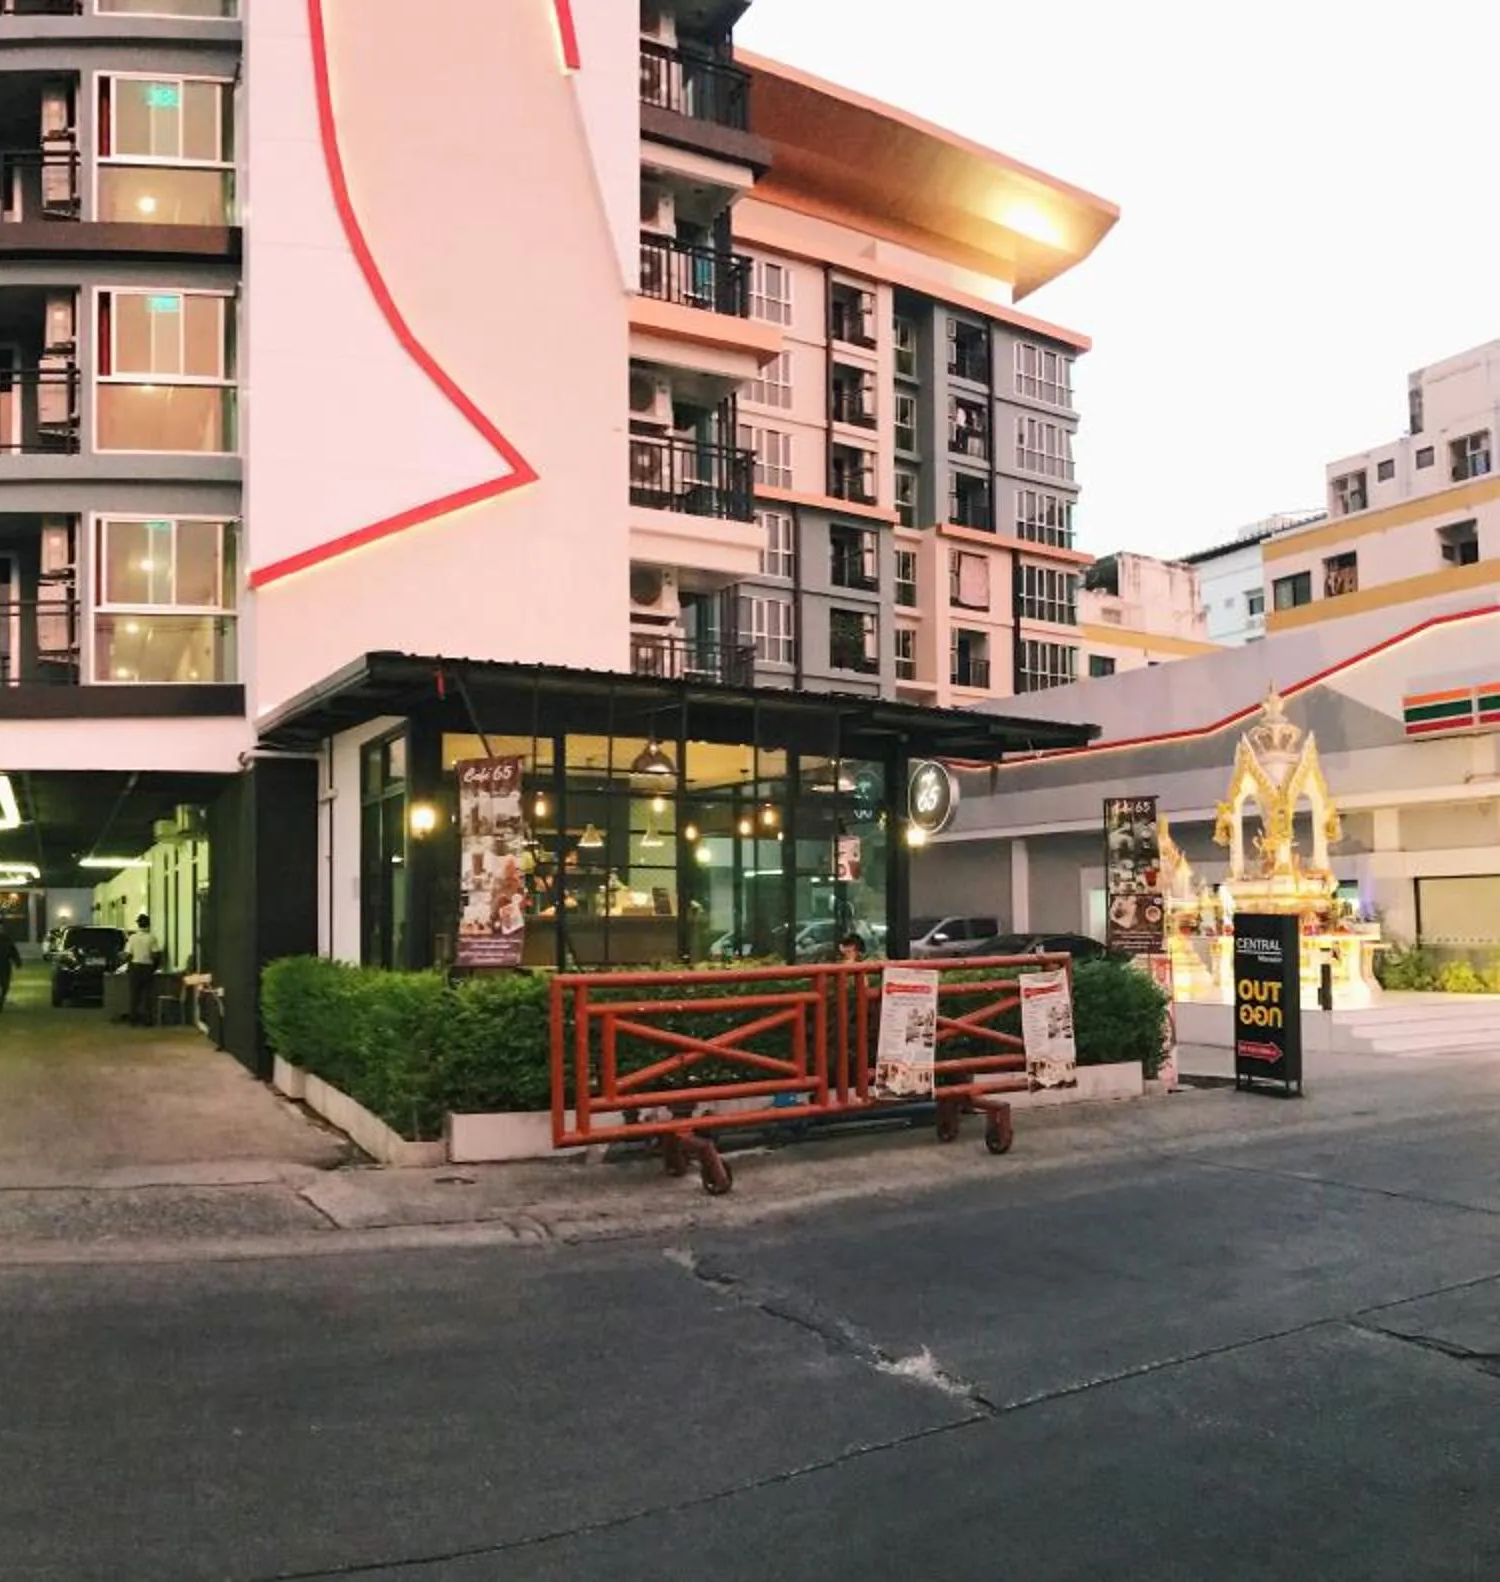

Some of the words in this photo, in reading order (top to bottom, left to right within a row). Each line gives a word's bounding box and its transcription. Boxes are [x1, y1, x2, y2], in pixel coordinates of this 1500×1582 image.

[492, 765, 513, 781] 65
[917, 785, 941, 812] 65
[1235, 937, 1282, 951] CENTRAL
[1237, 979, 1283, 1003] OUT
[1238, 1004, 1283, 1028] ออก
